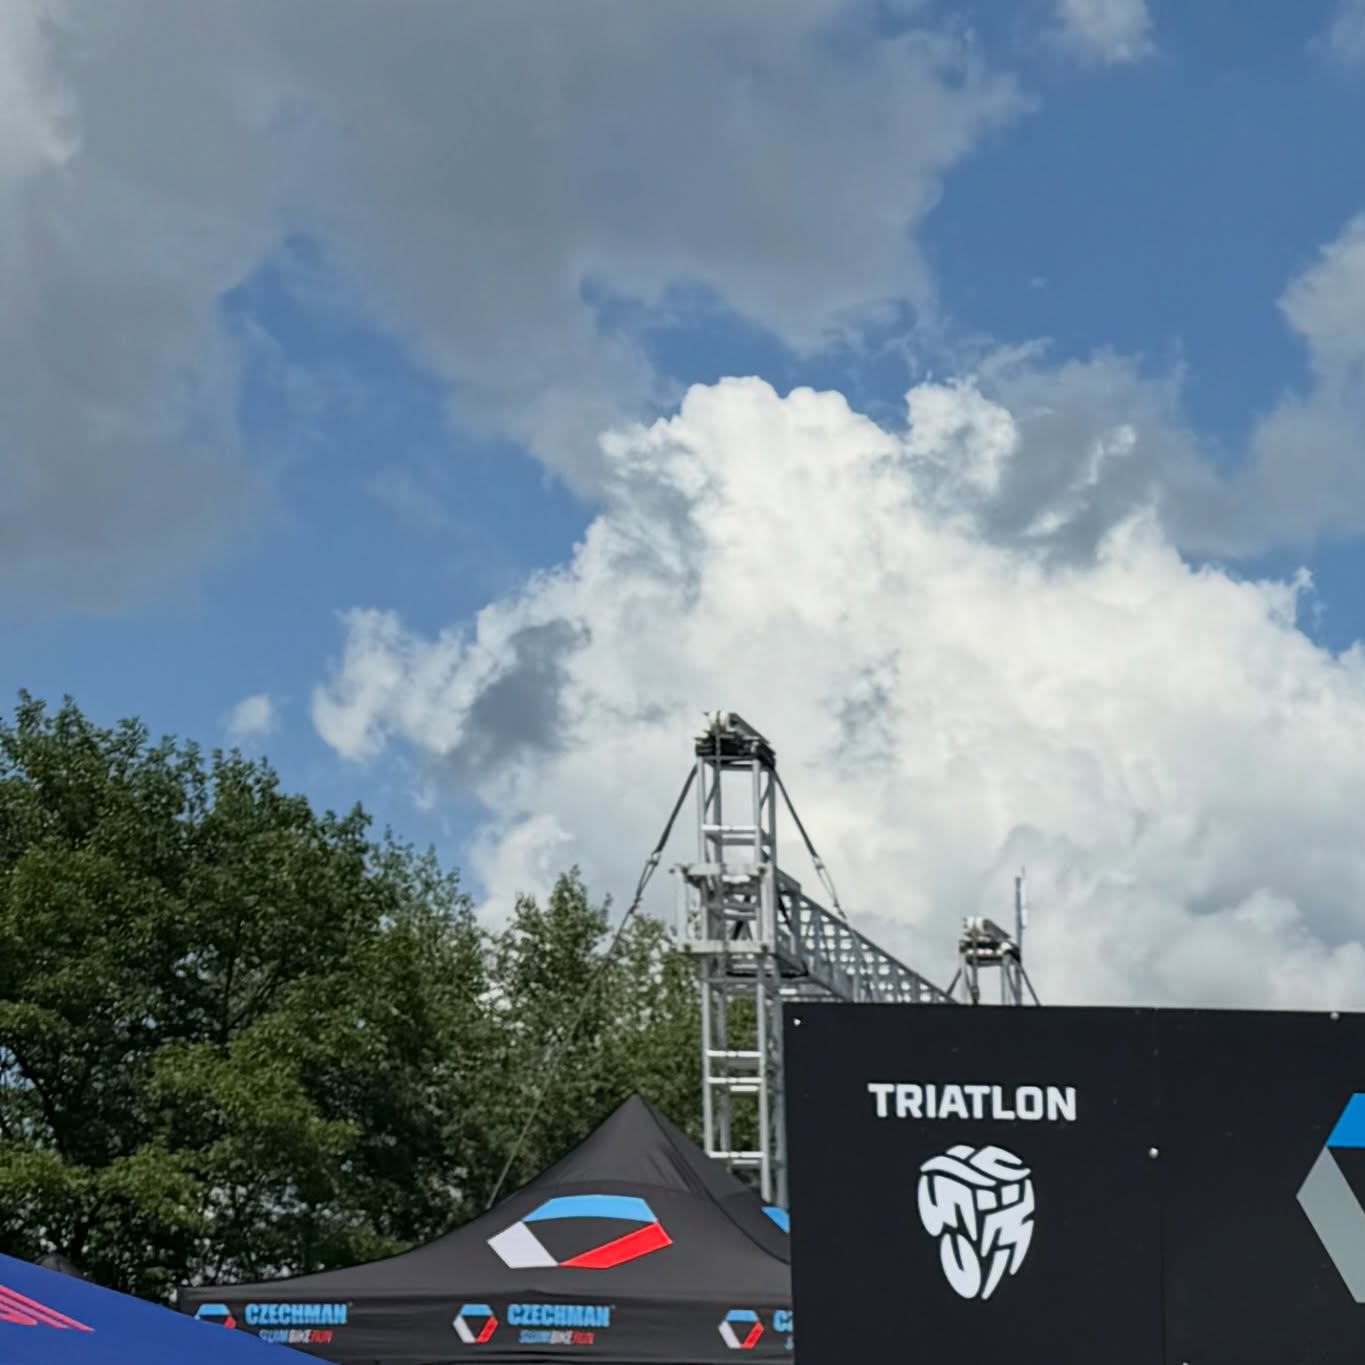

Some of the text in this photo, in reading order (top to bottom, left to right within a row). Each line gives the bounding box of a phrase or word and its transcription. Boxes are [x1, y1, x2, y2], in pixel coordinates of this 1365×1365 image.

[868, 1083, 1077, 1121] TRIATLON
[245, 1303, 348, 1326] CZECHMAN
[507, 1304, 610, 1328] CZECHMAN
